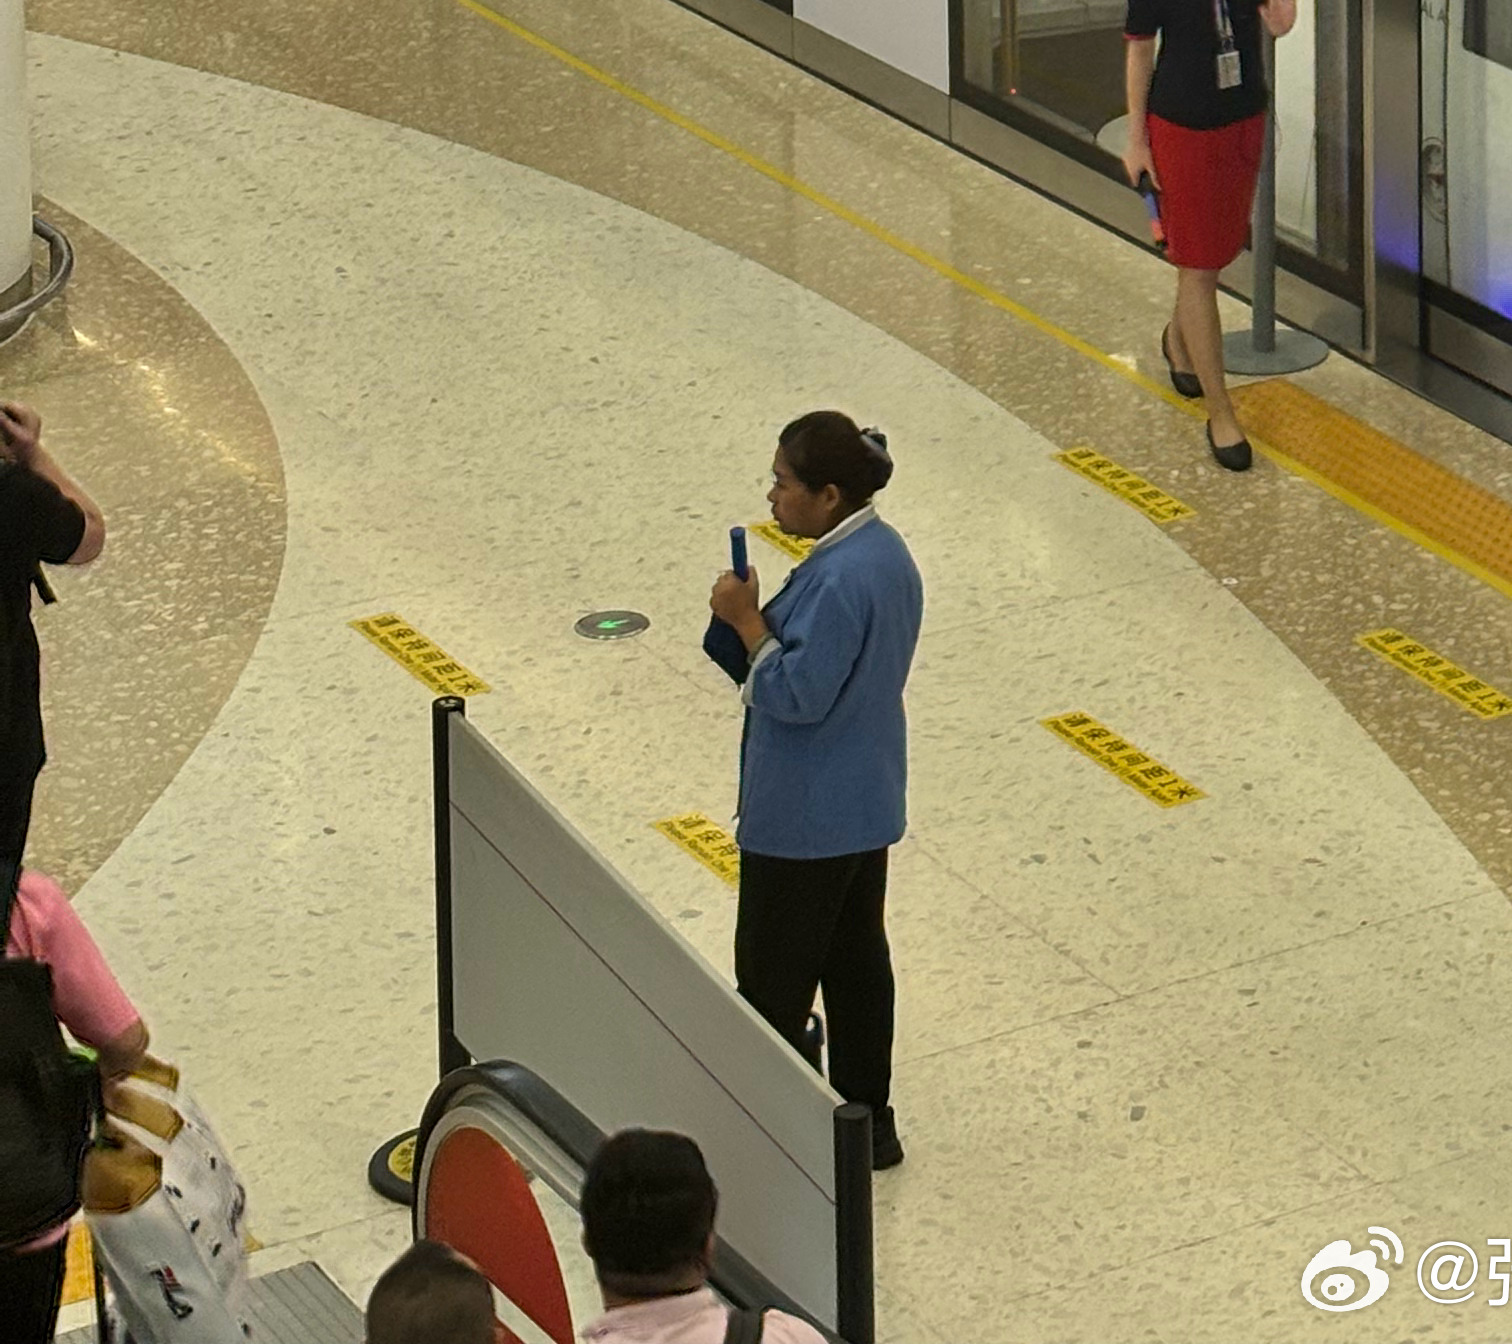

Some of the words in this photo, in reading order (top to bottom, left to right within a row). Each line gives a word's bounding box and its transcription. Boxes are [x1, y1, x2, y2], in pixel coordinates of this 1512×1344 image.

[1063, 714, 1198, 799] 请保持间距1米
[679, 815, 739, 865] 请保持
